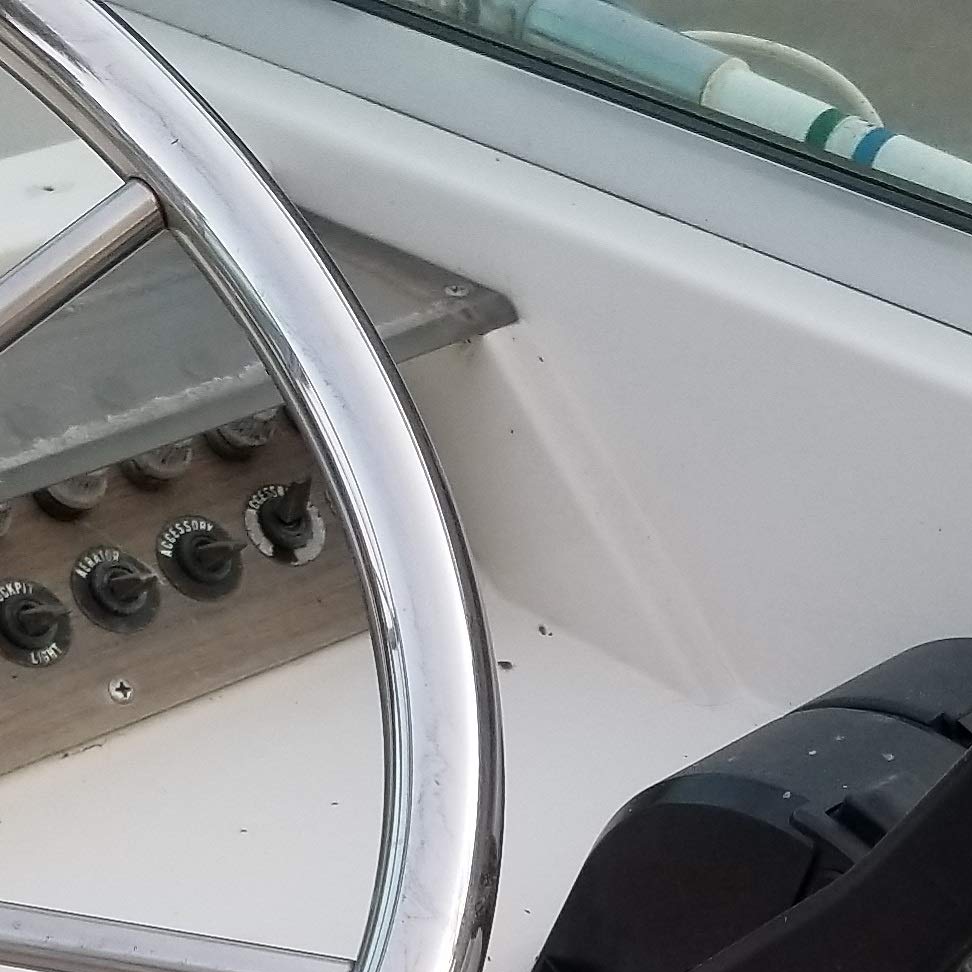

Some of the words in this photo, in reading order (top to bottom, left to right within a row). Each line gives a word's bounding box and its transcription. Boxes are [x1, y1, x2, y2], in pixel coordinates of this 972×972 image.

[160, 520, 214, 558] ACCESSORY
[75, 549, 120, 579] AERATOR
[31, 642, 63, 665] LIGHT
